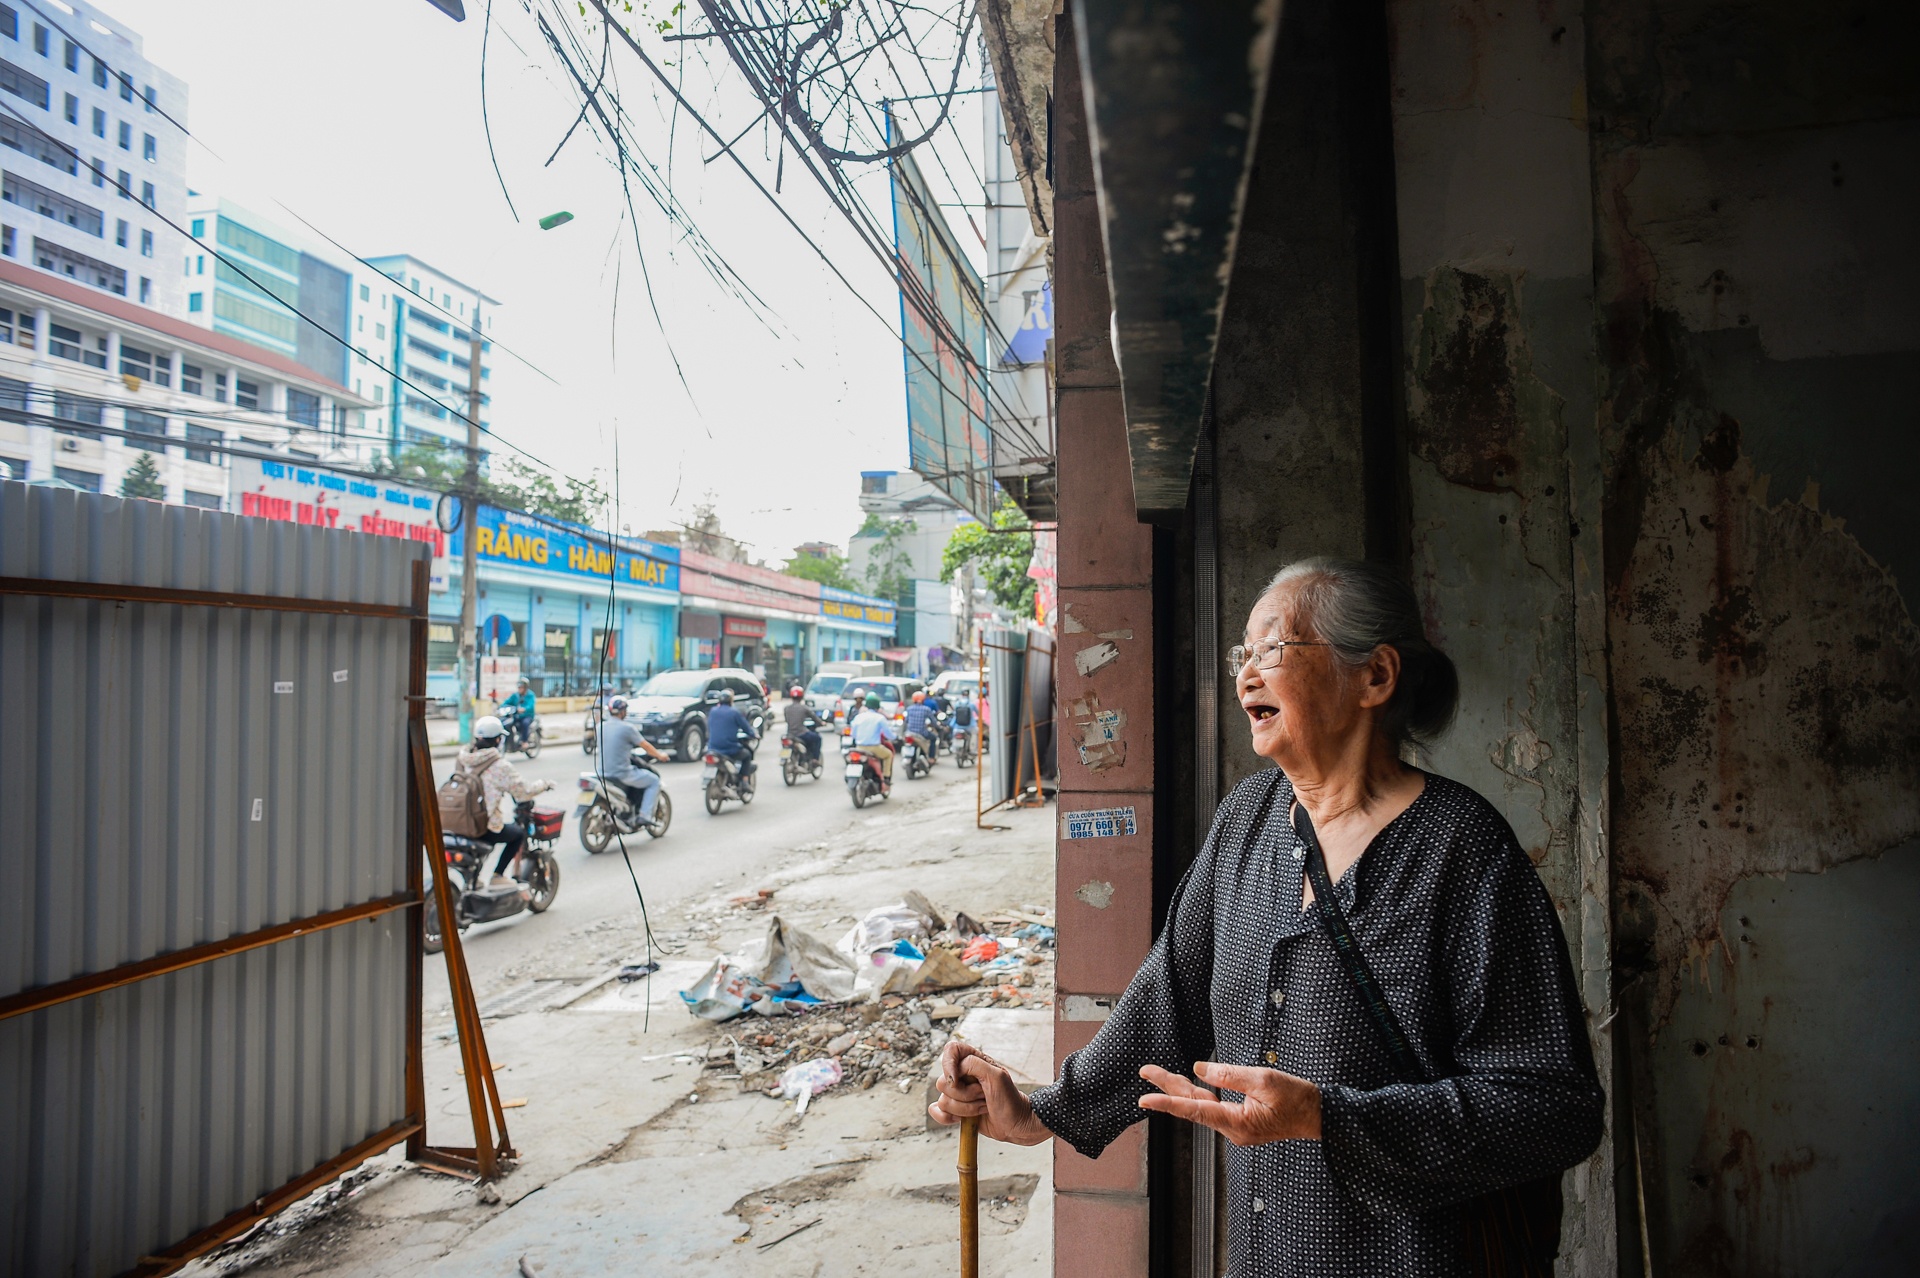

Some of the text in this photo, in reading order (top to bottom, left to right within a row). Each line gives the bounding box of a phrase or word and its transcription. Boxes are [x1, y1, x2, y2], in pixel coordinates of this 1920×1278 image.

[287, 465, 295, 481] Y
[242, 485, 291, 522] KÍNH
[476, 523, 548, 564] RĂNG
[568, 542, 616, 575] HÀM
[1070, 821, 1093, 832] 0977
[1096, 820, 1113, 830] 660
[1116, 818, 1134, 829] 64
[1071, 830, 1094, 840] 0985
[1097, 829, 1114, 837] 148
